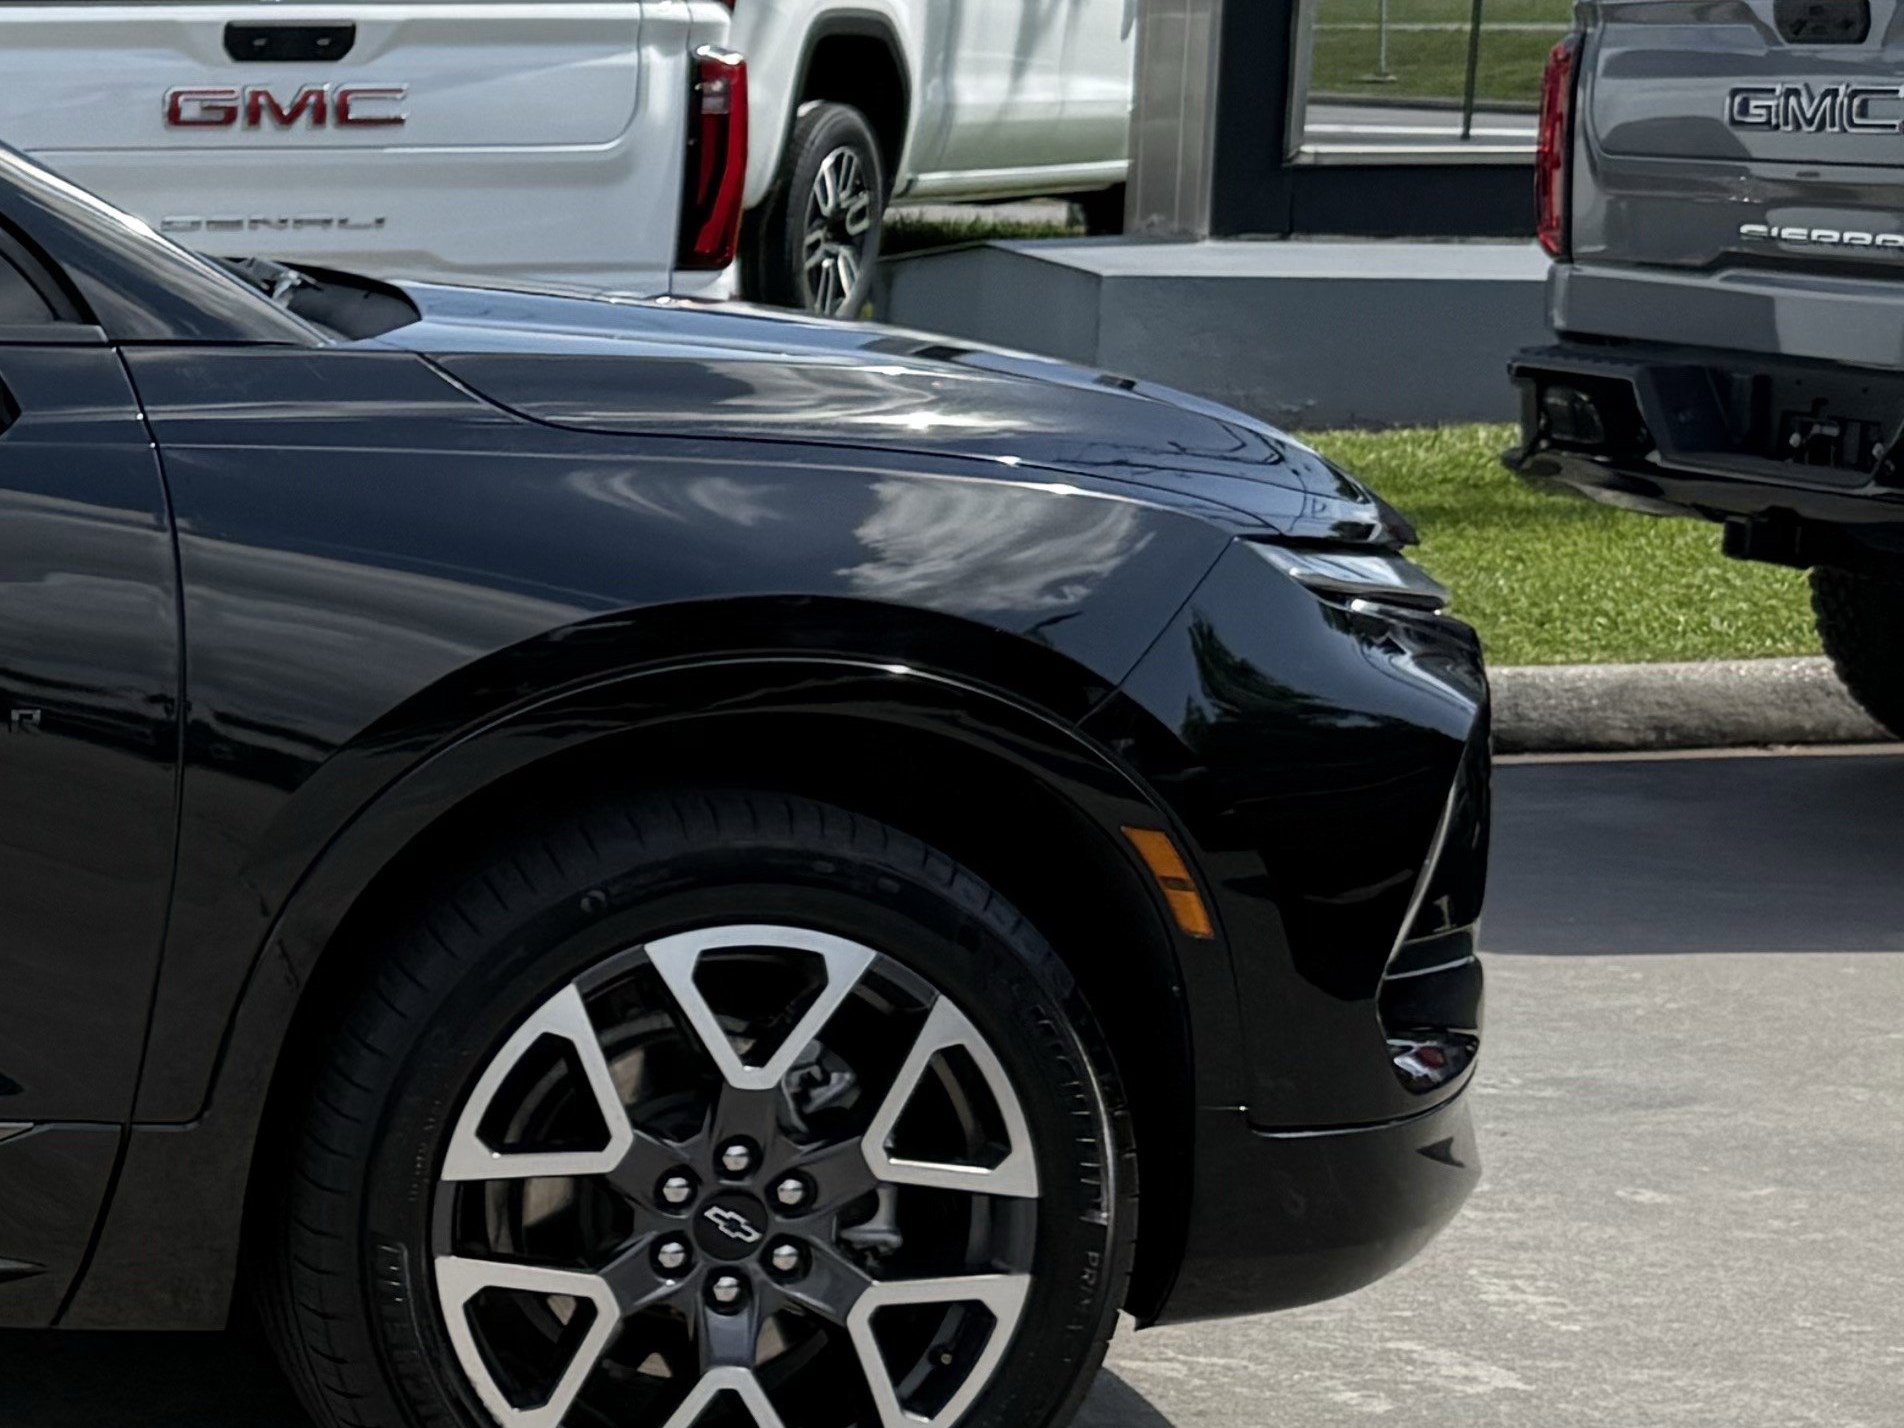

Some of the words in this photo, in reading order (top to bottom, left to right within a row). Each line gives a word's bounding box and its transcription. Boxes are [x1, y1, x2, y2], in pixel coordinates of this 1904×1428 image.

[162, 82, 410, 129] GMC
[1725, 84, 1904, 134] GMC
[161, 215, 387, 233] DENALI
[1739, 223, 1904, 249] SIERRA
